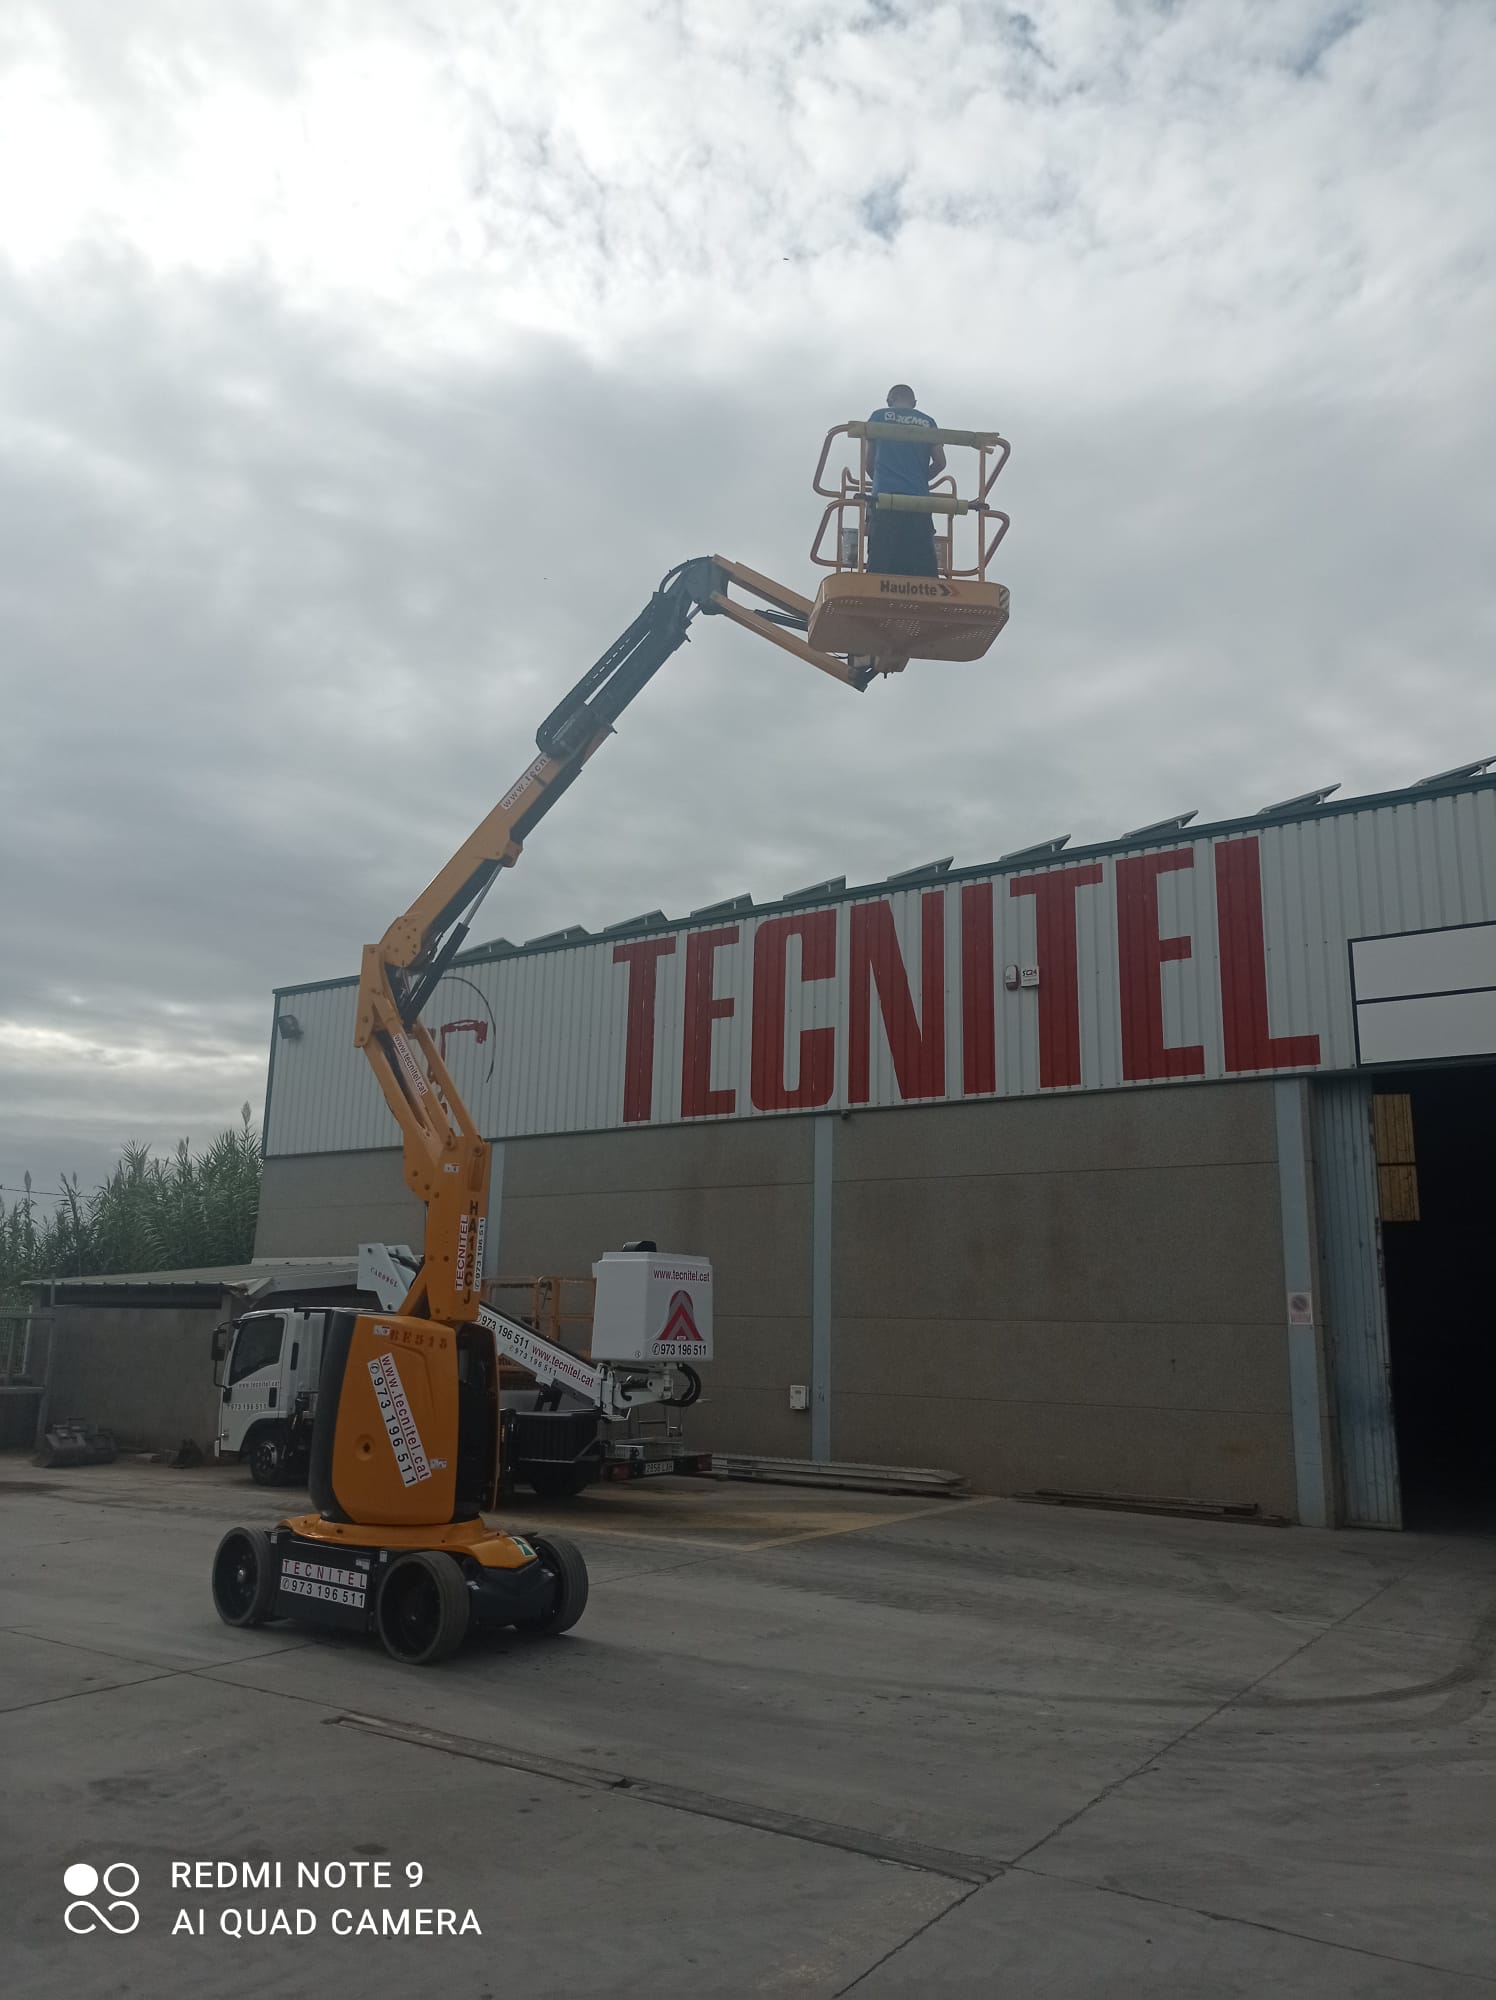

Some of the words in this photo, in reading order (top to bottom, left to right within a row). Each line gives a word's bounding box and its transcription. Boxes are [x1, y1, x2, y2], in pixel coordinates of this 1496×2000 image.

[880, 581, 937, 596] Haulotte
[612, 836, 1321, 1123] TECNITEL
[394, 1033, 427, 1095] www.tecnitel.cat
[455, 1216, 469, 1289] TECNITEL
[653, 1269, 710, 1282] www.tecnitel.cat
[481, 1315, 497, 1330] 973
[498, 1325, 513, 1340] 196
[513, 1336, 529, 1349] 511
[532, 1345, 594, 1387] www.tecnitel.cat
[514, 1348, 528, 1360] 973
[543, 1363, 557, 1376] 511
[661, 1344, 675, 1355] 973
[678, 1344, 691, 1355] 196
[693, 1345, 706, 1355] 511
[373, 1377, 391, 1409] 973
[385, 1414, 404, 1447] 196
[397, 1453, 417, 1485] 511
[381, 1356, 430, 1480] www.tecnitel.cat
[283, 1560, 366, 1588] TECNITEL
[291, 1580, 313, 1595] 973
[317, 1585, 338, 1600] 196
[342, 1591, 364, 1606] 511
